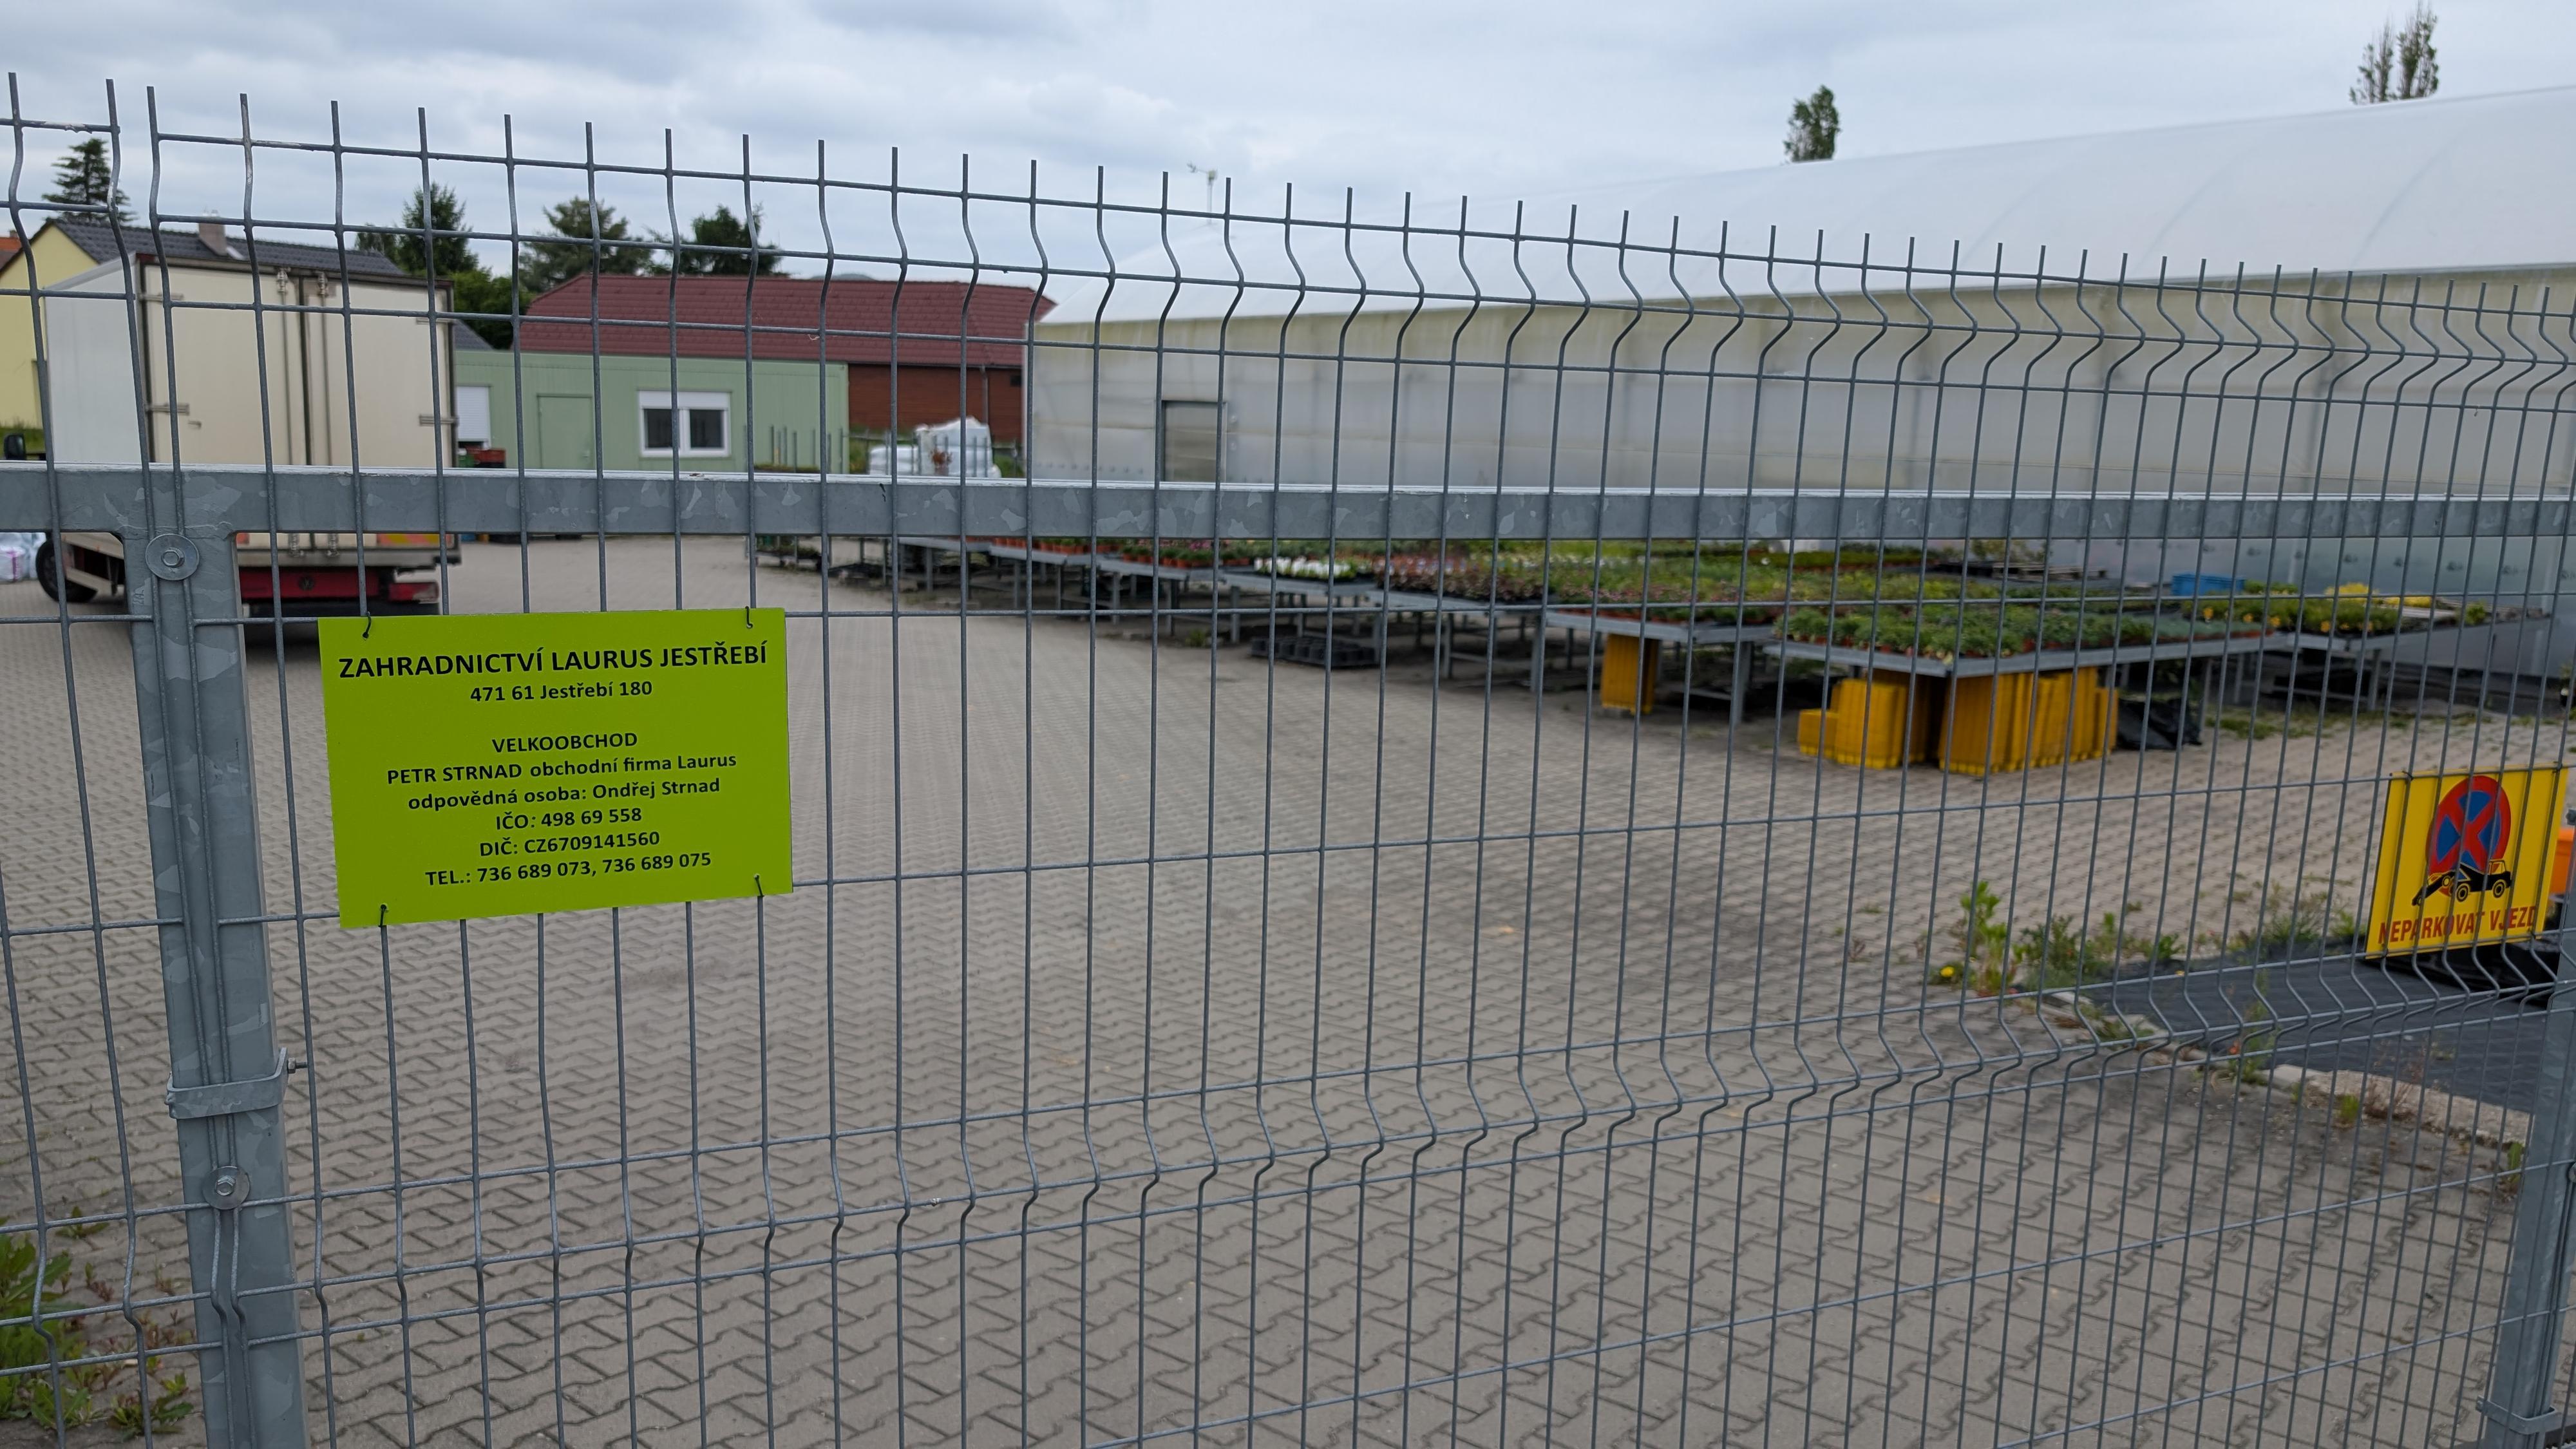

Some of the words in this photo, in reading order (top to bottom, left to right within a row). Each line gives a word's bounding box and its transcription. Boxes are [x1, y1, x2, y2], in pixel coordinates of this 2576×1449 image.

[338, 646, 544, 679] ZAHRADNICTVÍ
[551, 649, 653, 671] LAURUS
[660, 640, 768, 667] JESTŘEBÍ
[470, 687, 506, 702] 471
[512, 686, 535, 701] 61
[540, 681, 614, 699] Jestřebí
[619, 681, 652, 696] 180
[492, 733, 638, 753] VELKOOBCHOD
[387, 768, 437, 784] PETR
[442, 764, 522, 782] STRNAD
[530, 757, 618, 777] obchodní
[623, 757, 672, 772] firma
[678, 755, 737, 769] Laurus
[408, 790, 518, 811] odpovědná
[524, 790, 587, 803] osoba:
[592, 781, 656, 800] Ondřej
[661, 777, 720, 795] Strnad
[496, 811, 536, 830] IČO:
[541, 812, 575, 827] 498
[581, 810, 603, 825] 69
[609, 808, 642, 823] 558
[480, 837, 518, 857] DIČ:
[524, 831, 660, 853] CZ6709141560
[425, 871, 471, 886] TEL.:
[477, 866, 512, 882] 736
[517, 863, 552, 880] 689
[557, 860, 596, 877] 073,
[602, 857, 636, 873] 736
[641, 855, 674, 871] 689
[679, 852, 711, 867] 075
[2489, 906, 2536, 931] VJEZD
